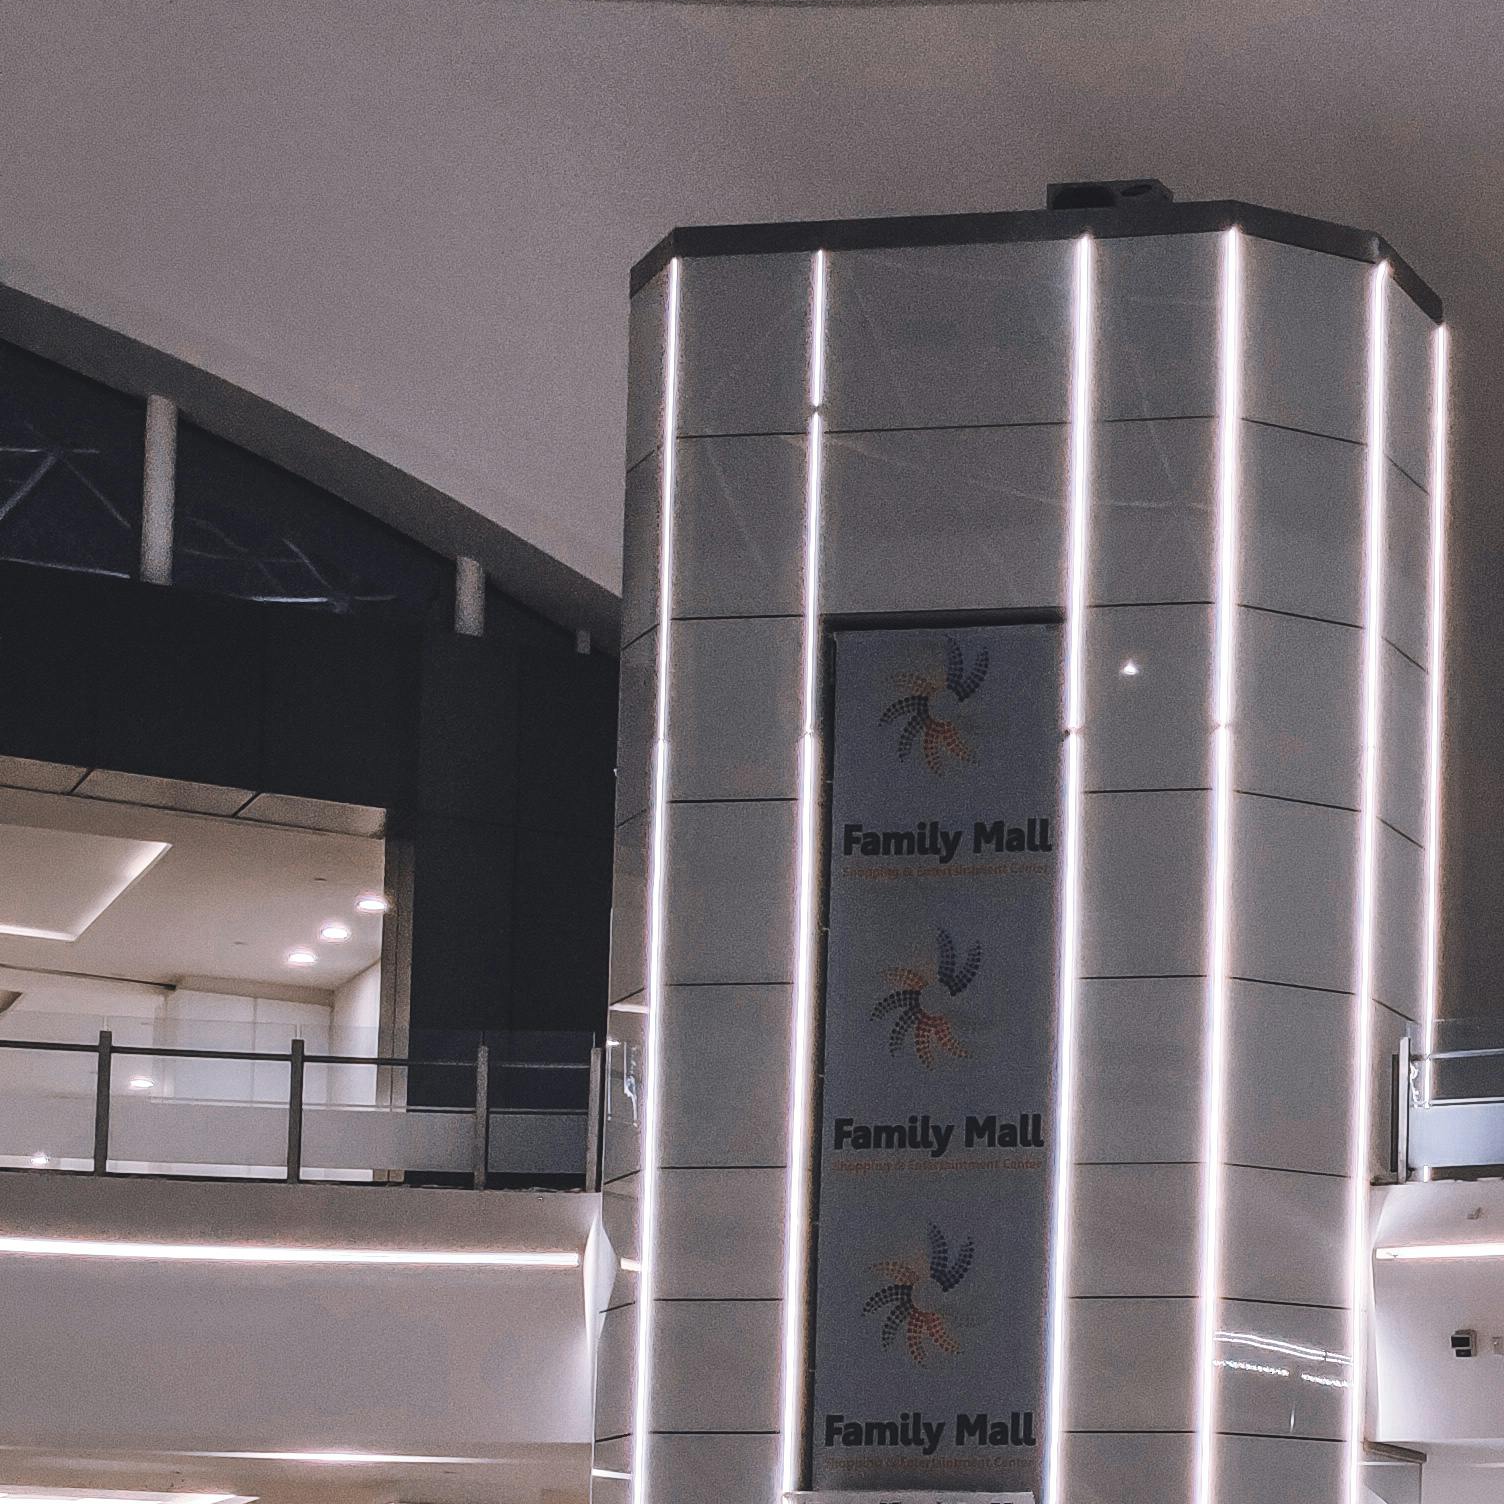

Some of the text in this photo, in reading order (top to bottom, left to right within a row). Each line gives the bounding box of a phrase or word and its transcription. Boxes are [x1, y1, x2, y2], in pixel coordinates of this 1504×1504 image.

[843, 818, 1052, 864] Family Mall
[834, 1113, 1045, 1158] Family Mall
[824, 1411, 1036, 1456] Family Mall
